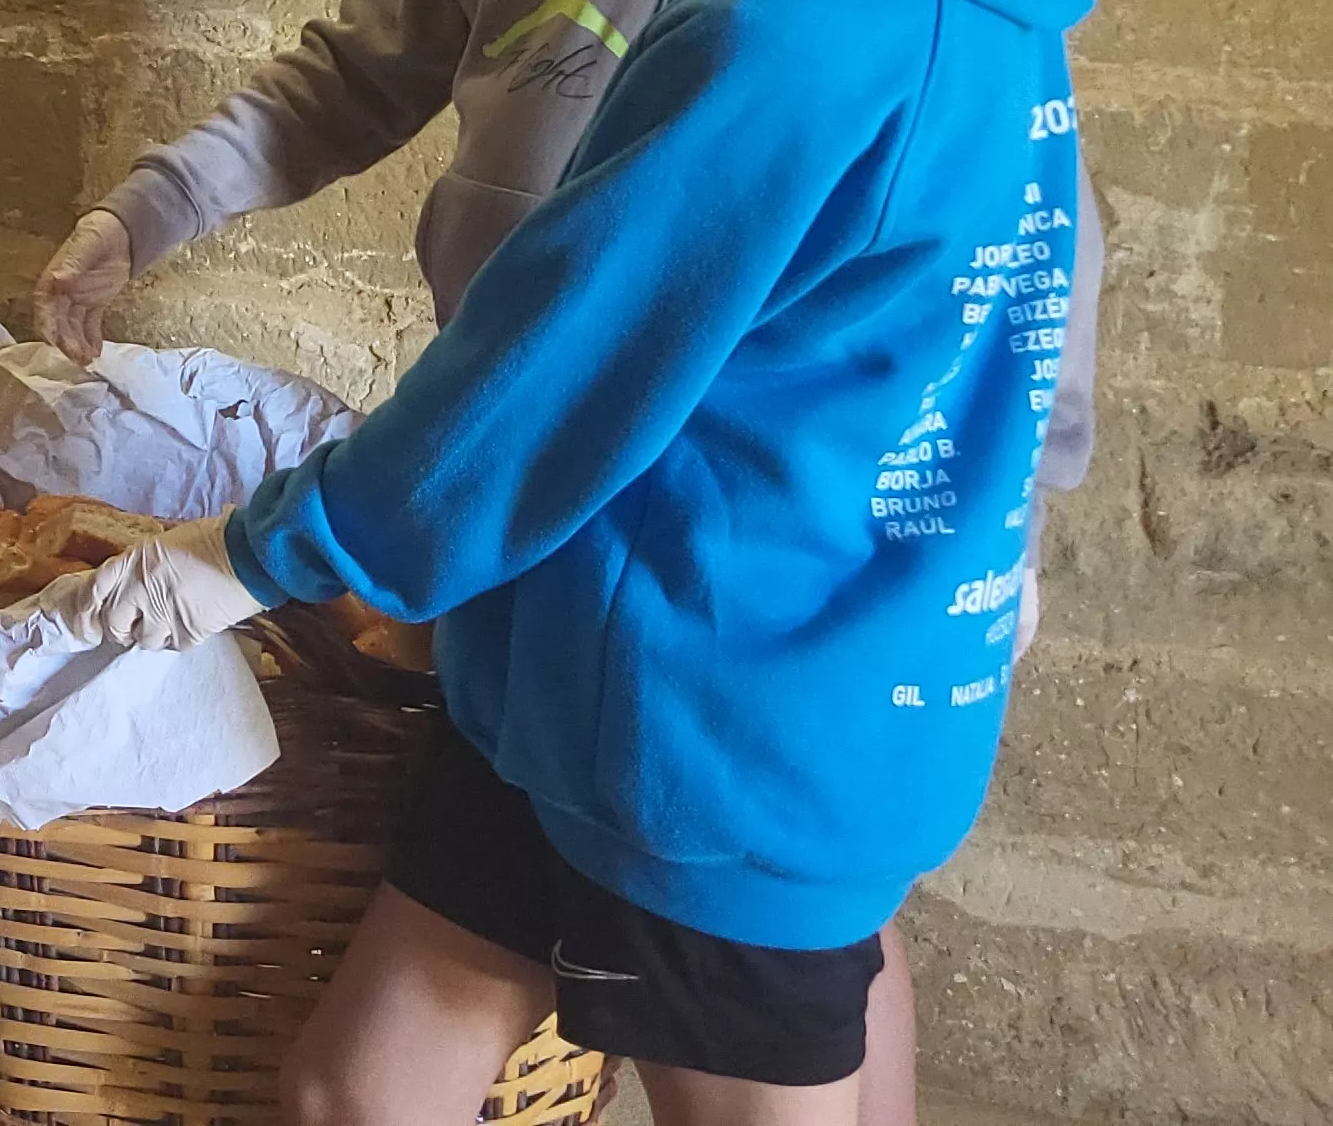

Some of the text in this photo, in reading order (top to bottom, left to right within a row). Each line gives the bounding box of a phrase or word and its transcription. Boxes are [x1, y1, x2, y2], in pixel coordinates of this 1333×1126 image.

[876, 469, 951, 491] BORJA
[871, 491, 957, 518] BRUNO
[892, 685, 926, 707] GIL
